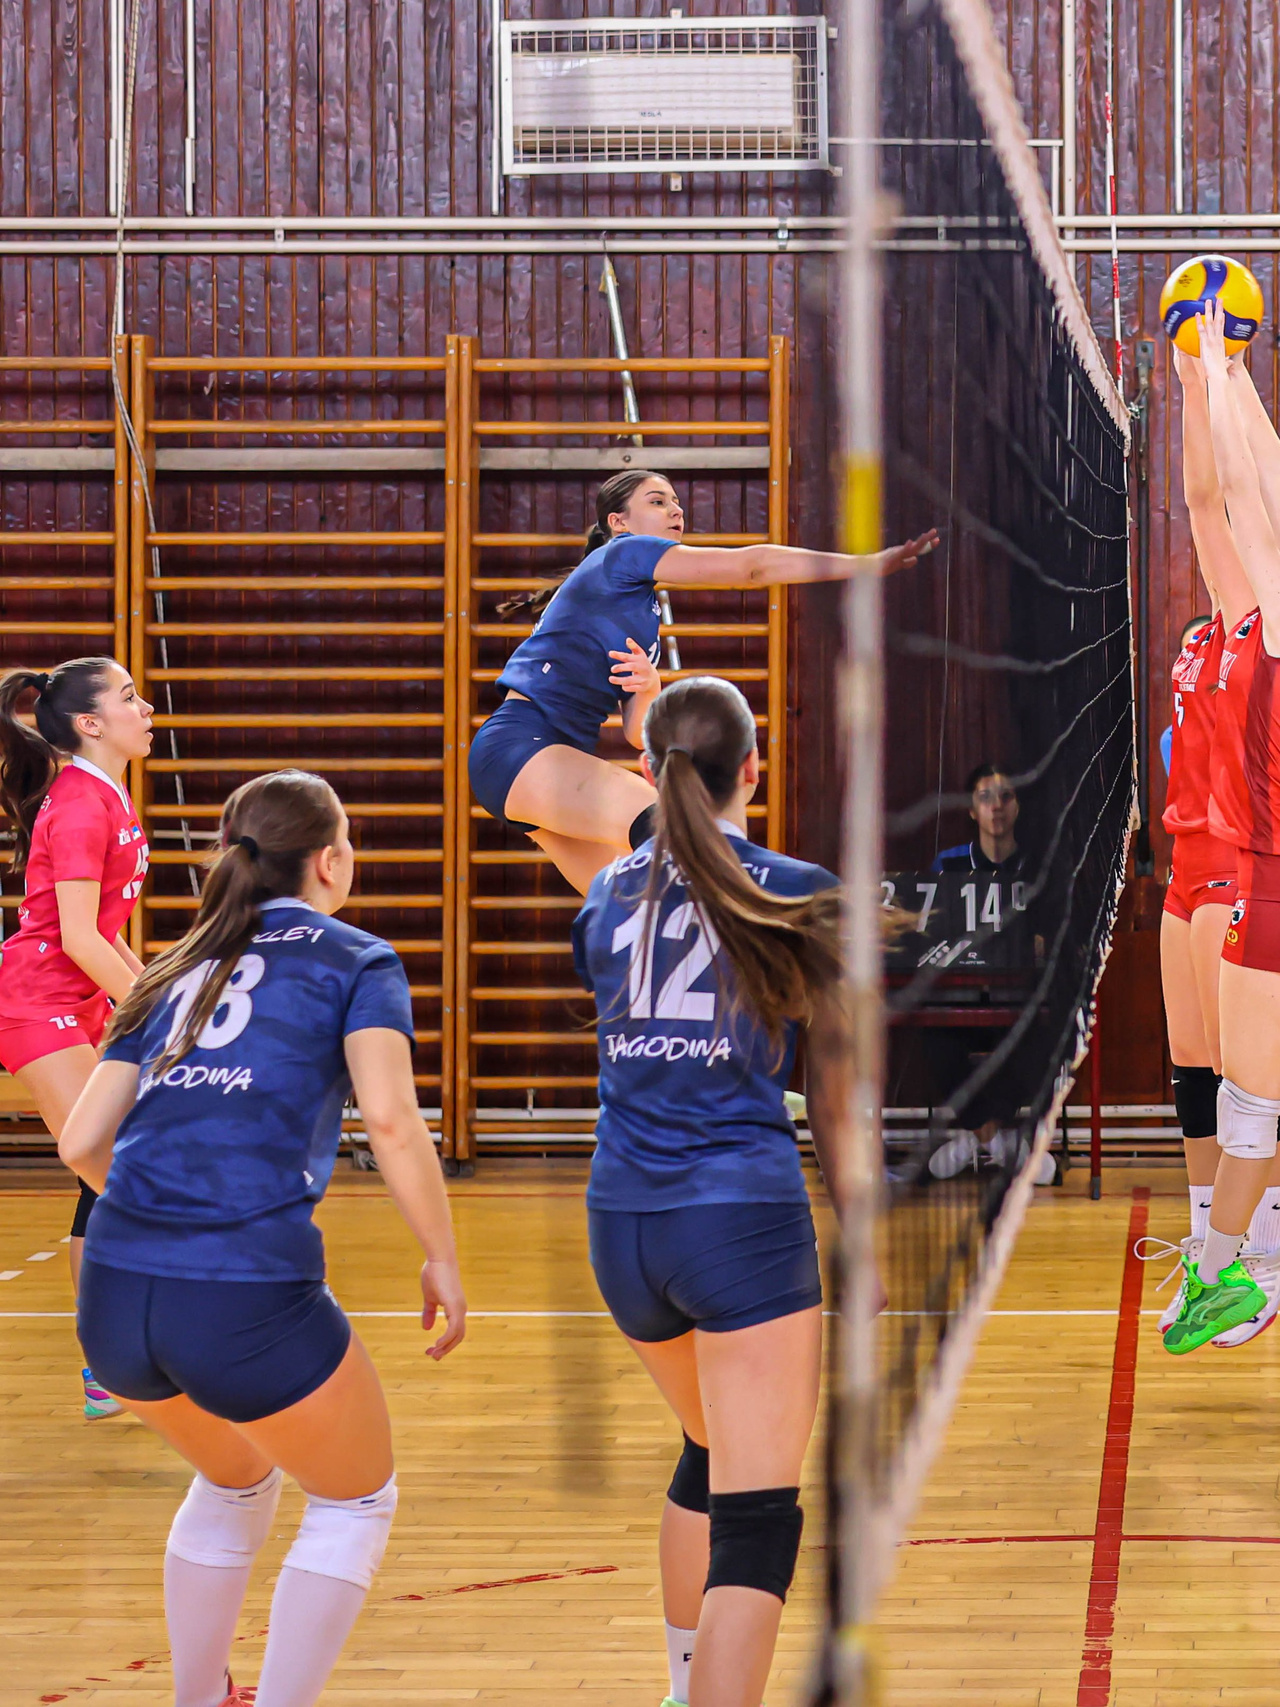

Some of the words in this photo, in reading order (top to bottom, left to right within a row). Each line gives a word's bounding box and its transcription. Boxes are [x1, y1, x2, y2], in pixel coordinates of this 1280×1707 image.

[916, 882, 938, 933] 7
[960, 882, 1002, 933] 14
[611, 900, 721, 1020] 12
[166, 953, 265, 1056] 18
[605, 1033, 732, 1067] JAGODINA
